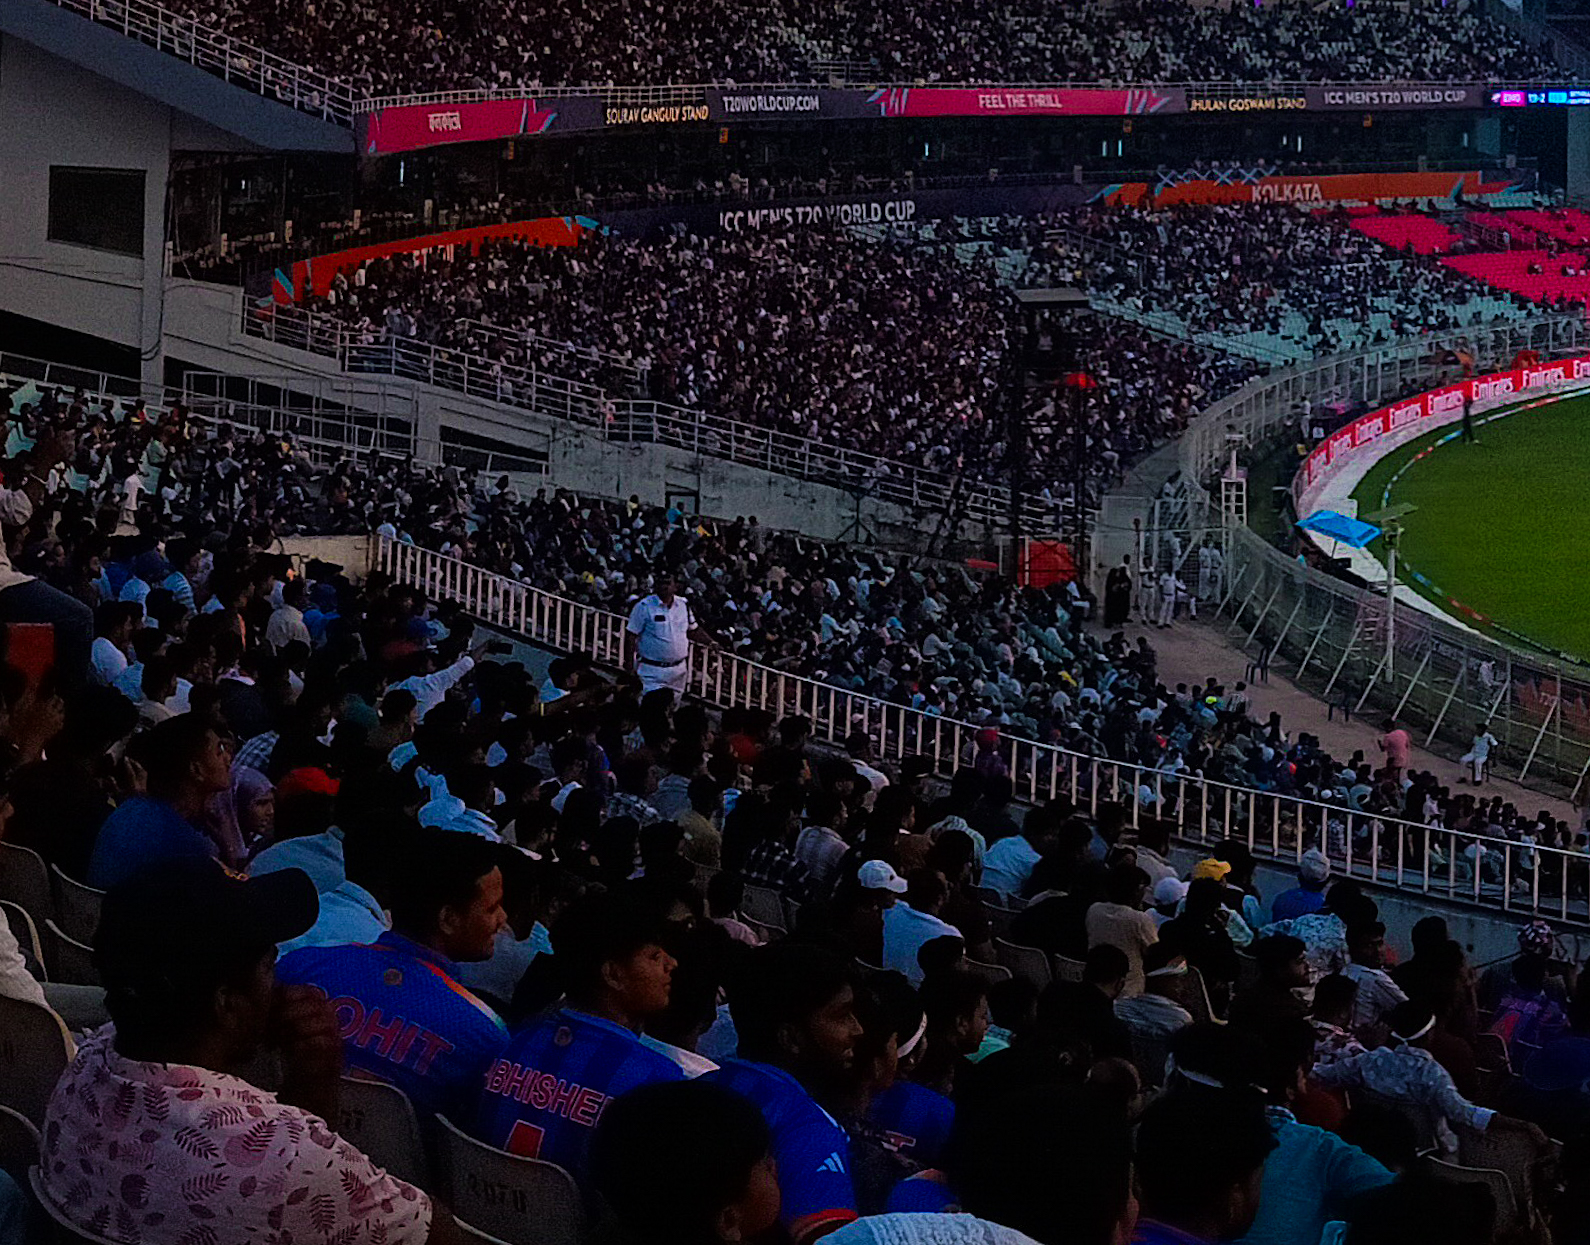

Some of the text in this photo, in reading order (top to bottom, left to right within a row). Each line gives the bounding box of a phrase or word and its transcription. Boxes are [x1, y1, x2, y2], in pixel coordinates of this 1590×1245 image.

[722, 95, 820, 113] T20WORLDCUP.COM
[978, 93, 1063, 109] FEEL THE THRILL
[1190, 97, 1306, 111] JHULAN GOSWAMI STAND
[1324, 90, 1466, 105] ICC MEN'S T20 WORLD CUP
[606, 105, 710, 125] SOURAV GANGULY STAND
[1252, 183, 1322, 203] KOLKATA
[795, 207, 822, 225] T20
[884, 200, 916, 223] CUP
[1472, 377, 1514, 401] Emirates
[1522, 365, 1564, 389] Emirates
[1428, 387, 1464, 415] Emirates
[1390, 401, 1422, 429] Emirates
[308, 983, 456, 1075] OHIT
[484, 1059, 612, 1128] BHISHE
